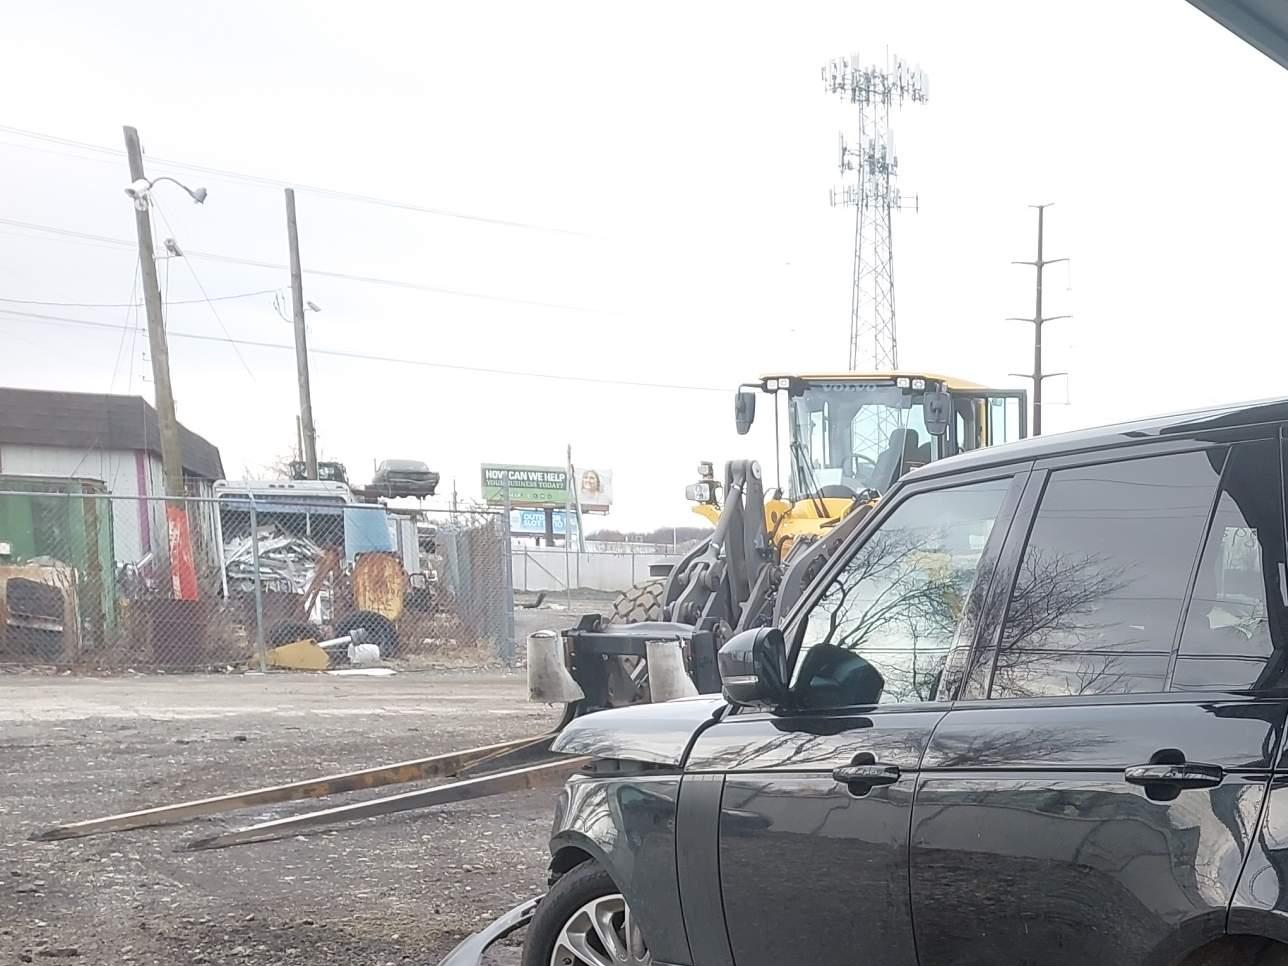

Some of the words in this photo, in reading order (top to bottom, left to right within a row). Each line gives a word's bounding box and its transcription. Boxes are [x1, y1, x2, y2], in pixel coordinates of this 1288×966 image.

[508, 471, 527, 480] CAN
[527, 472, 543, 481] WE
[544, 472, 565, 482] HELP
